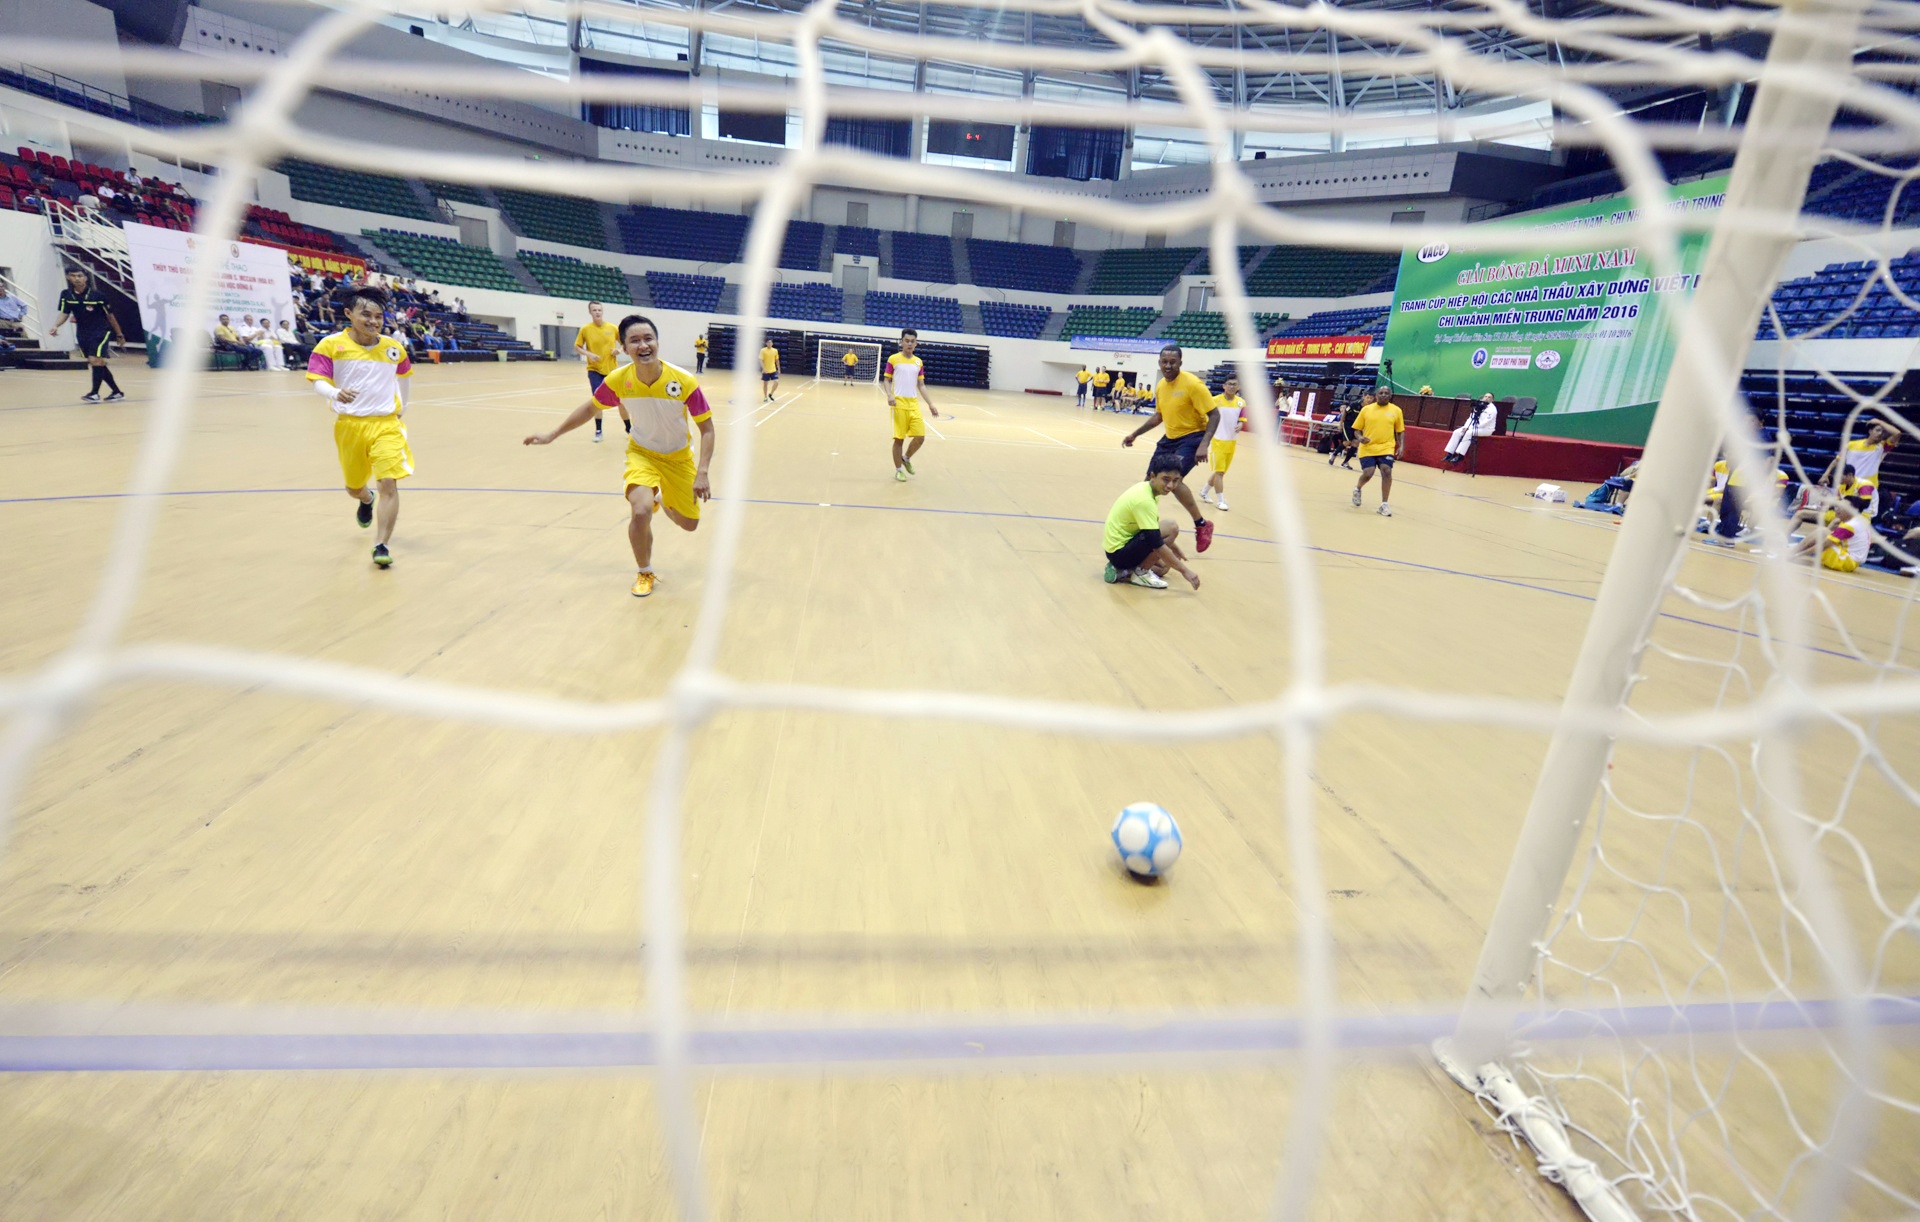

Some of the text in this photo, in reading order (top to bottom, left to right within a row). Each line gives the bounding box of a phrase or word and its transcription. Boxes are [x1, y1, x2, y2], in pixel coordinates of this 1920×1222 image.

[1610, 211, 1626, 226] CHI
[1692, 193, 1726, 212] TRUNG
[1422, 245, 1445, 259] VACC
[1457, 248, 1638, 285] GIẢI BÓNG ĐÁ MINI NAM
[1400, 300, 1426, 312] TRANH
[1428, 296, 1446, 309] CÚP
[1448, 294, 1469, 310] HIỆP
[1471, 292, 1487, 309] HỘI
[1490, 289, 1512, 305] CÁC
[1515, 286, 1539, 303] NHÀ
[1543, 282, 1574, 301] THẦU
[1577, 280, 1605, 297] XÂY
[1608, 277, 1650, 297] DỰNG
[1654, 273, 1691, 293] VIỆT
[1438, 315, 1455, 328] CHI
[1456, 312, 1491, 327] NHÁNH
[1524, 309, 1563, 324] TRUNG
[1566, 304, 1599, 322] NĂM
[1602, 305, 1638, 320] 2016
